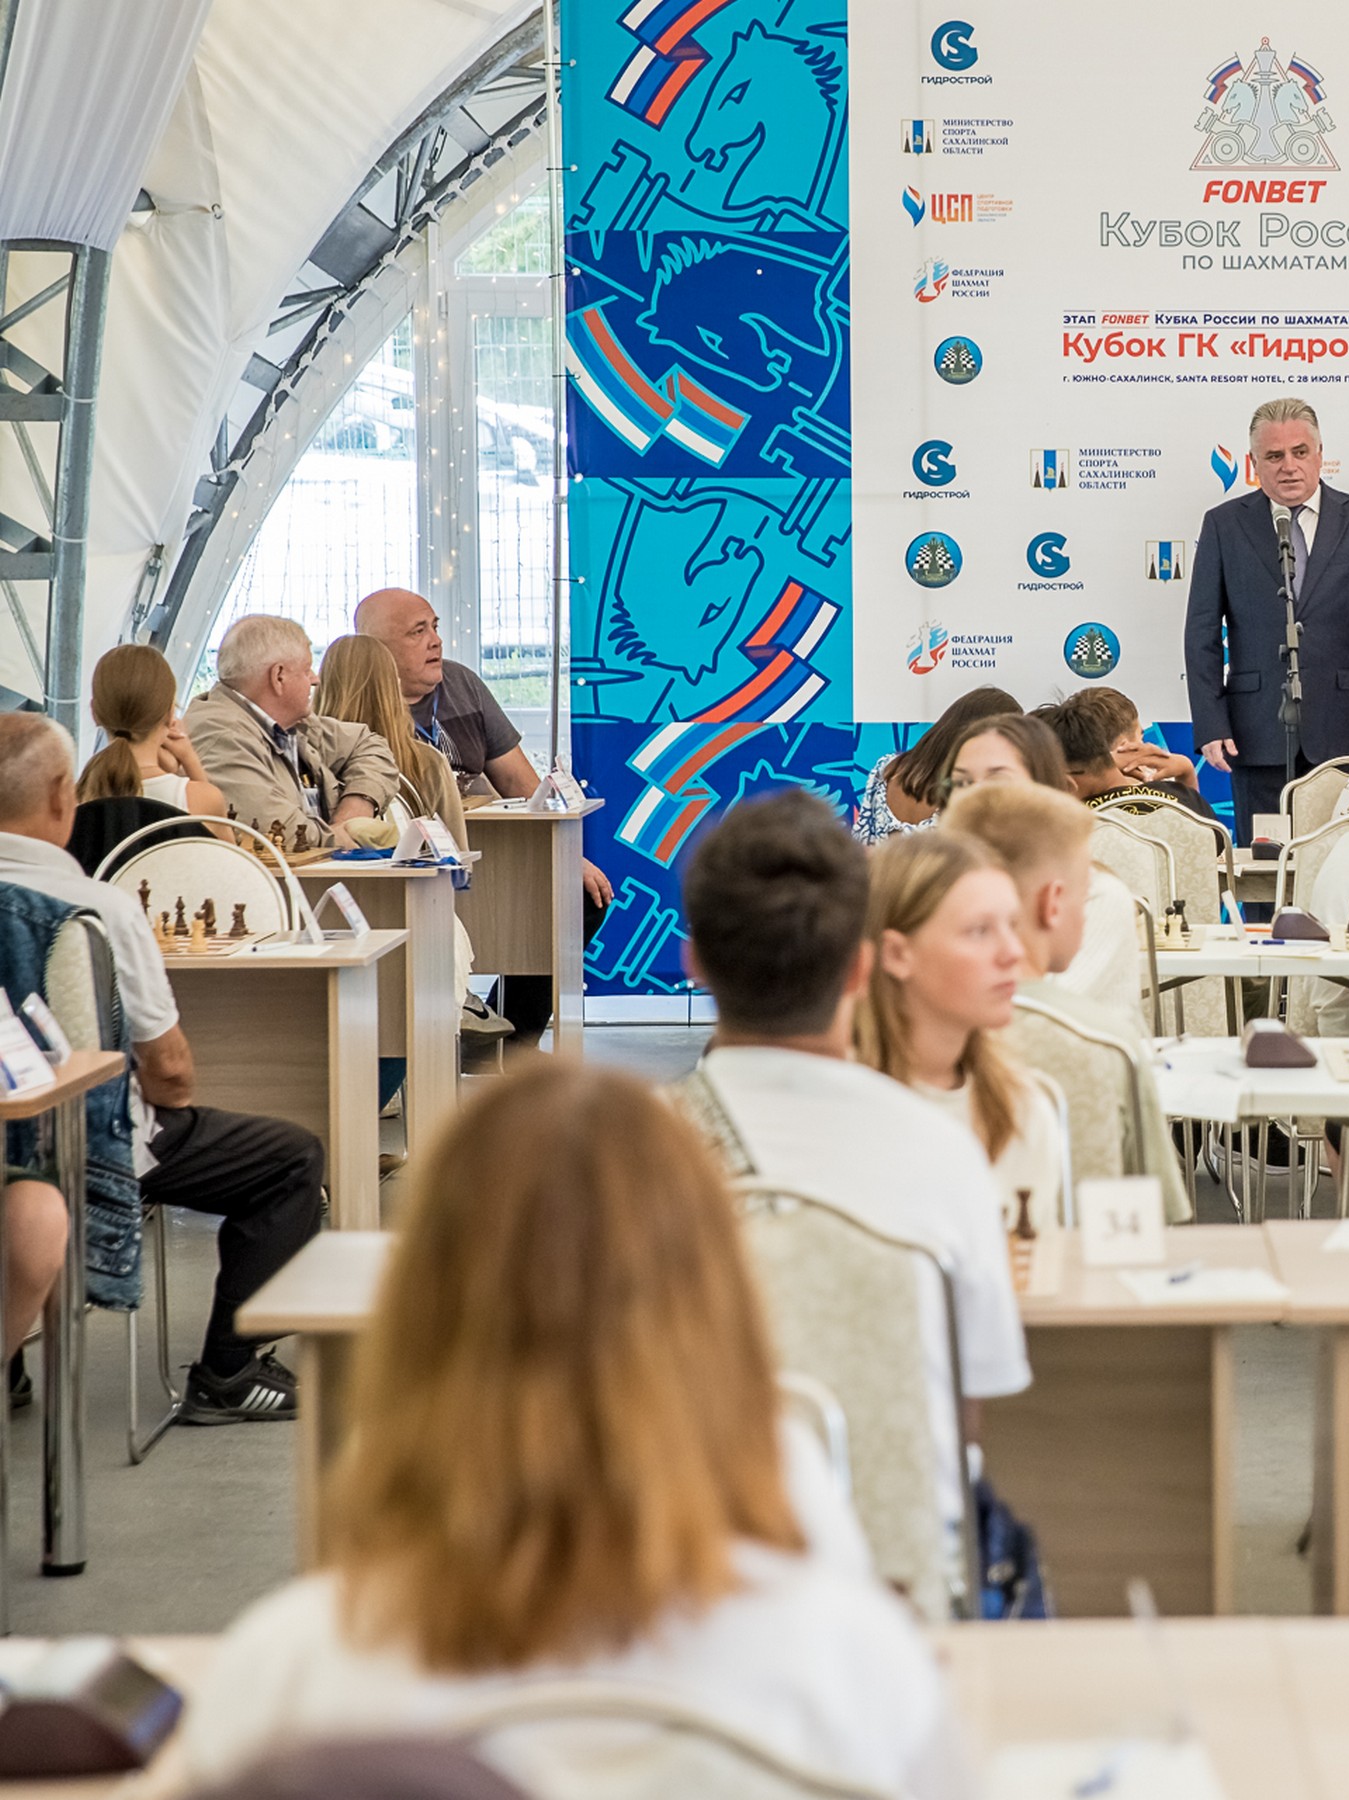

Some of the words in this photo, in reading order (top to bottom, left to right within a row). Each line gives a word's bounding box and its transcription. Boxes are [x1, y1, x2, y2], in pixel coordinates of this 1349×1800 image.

[921, 75, 993, 85] ГИДРОСТРОЙ
[943, 137, 1009, 145] САХАЛИНСКОЙ
[943, 147, 983, 155] ОБЛАСТИ
[1203, 180, 1327, 204] FONBET
[931, 194, 973, 224] ЦСП
[1183, 255, 1213, 271] ПО
[1222, 255, 1347, 271] ШАХМАТАМ
[952, 269, 1004, 277] ФЕДЕРАЦИЯ
[1063, 315, 1096, 325] ЭТАП
[1101, 314, 1149, 326] FONBET
[1261, 315, 1279, 326] ПО
[1063, 331, 1166, 363] Кубок
[1178, 332, 1218, 358] ГК
[1072, 374, 1174, 384] ЮЖНО-САХАЛИНСК,
[1176, 374, 1208, 383] SANTA
[1211, 374, 1248, 383] RESORT
[1251, 374, 1285, 385] HOTEL,
[1288, 375, 1295, 383] С
[1297, 375, 1308, 383] 28
[1311, 375, 1341, 383] ИЮЛЯ
[1079, 449, 1162, 457] МИНИСТЕРСТВО
[1079, 459, 1118, 468] СПОРТА
[1079, 469, 1156, 479] САХАЛИНСКОЙ
[1079, 481, 1127, 490] ОБЛАСТИ
[903, 490, 970, 499] ГИДРОСТРОЙ
[1018, 582, 1084, 591] ГИДРОСТРОЙ
[952, 634, 1013, 645] ФЕДЕРАЦИЯ
[952, 647, 996, 656] ШАХМАТ
[952, 659, 996, 668] РОССИИ
